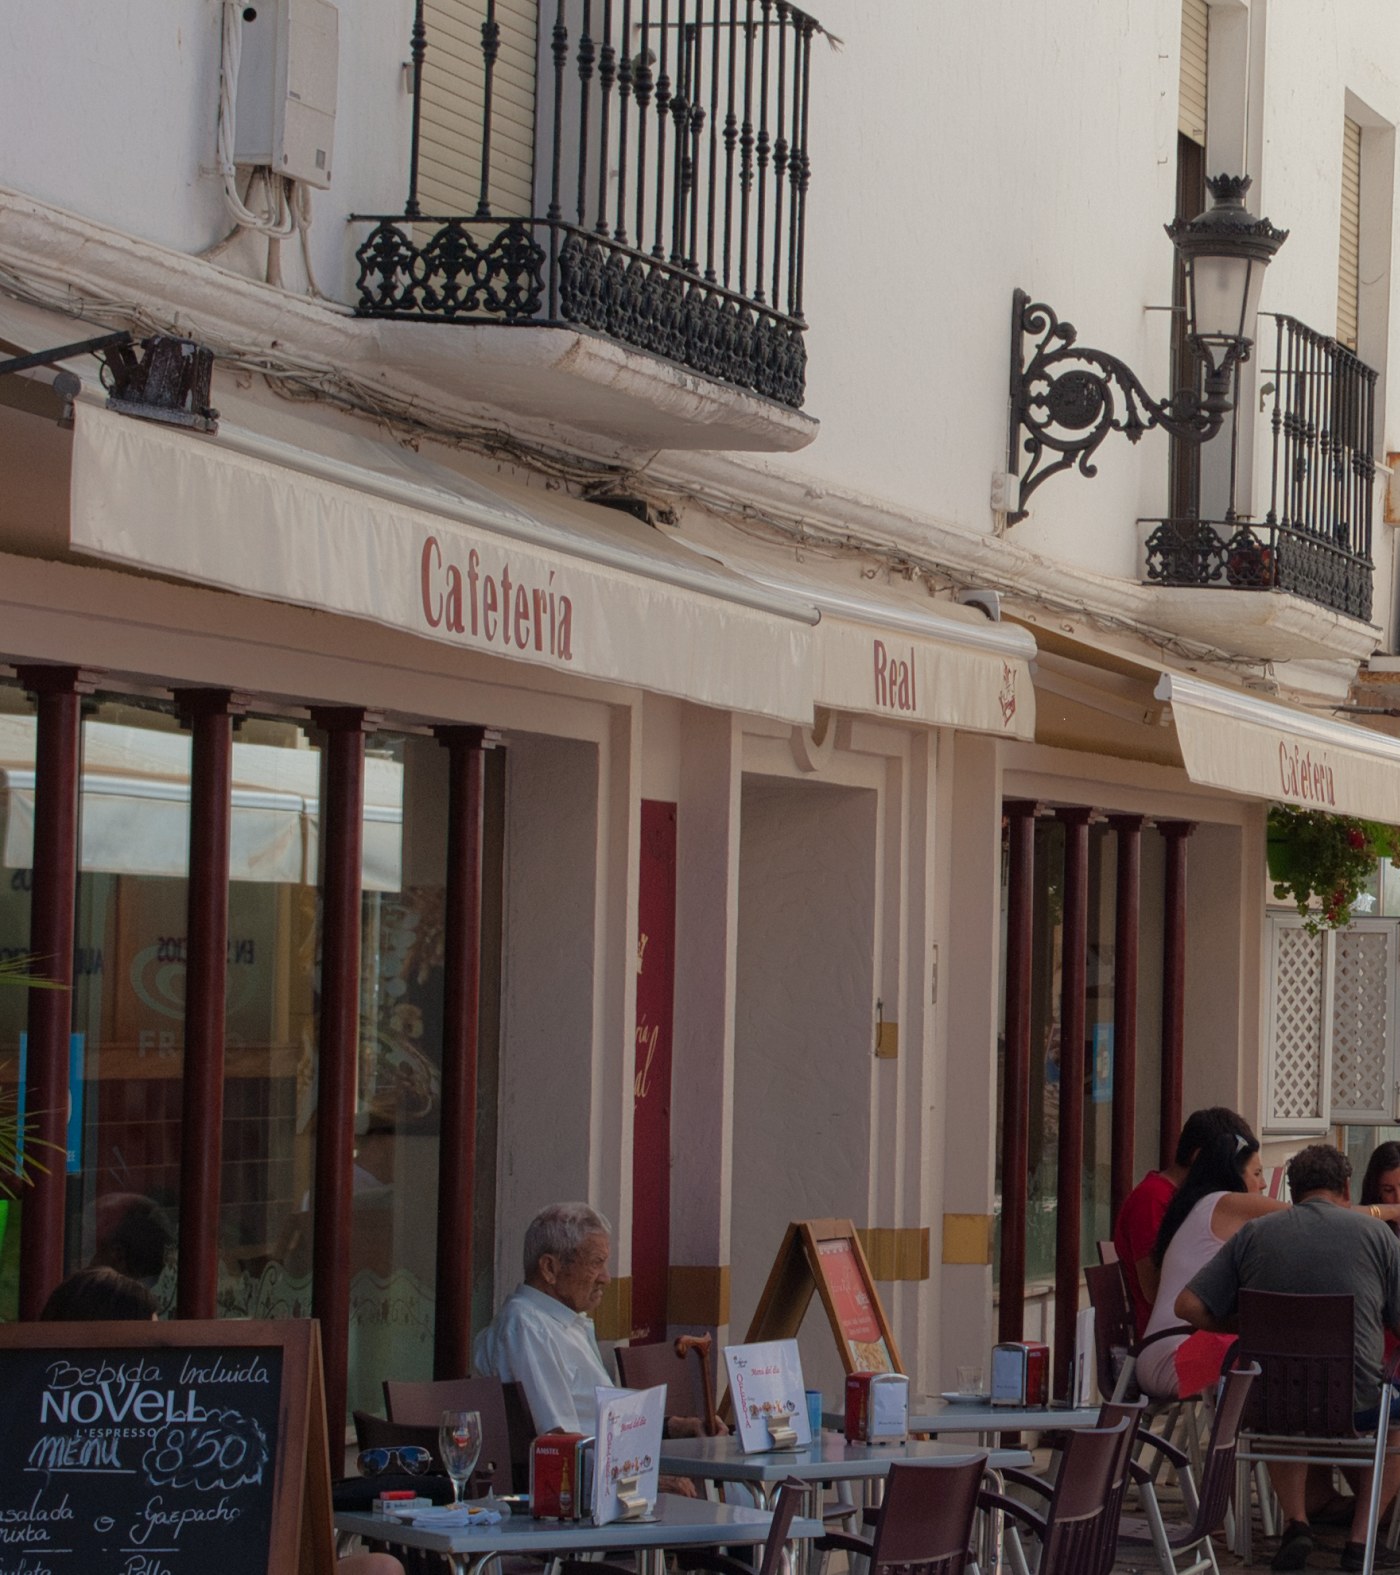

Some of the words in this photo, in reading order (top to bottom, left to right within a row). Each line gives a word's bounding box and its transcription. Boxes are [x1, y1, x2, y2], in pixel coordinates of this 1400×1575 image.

[421, 535, 573, 662] Cafetería
[873, 639, 917, 712] Real
[1279, 741, 1336, 806] Cafetería
[76, 1428, 158, 1439] L'ESPRESSO
